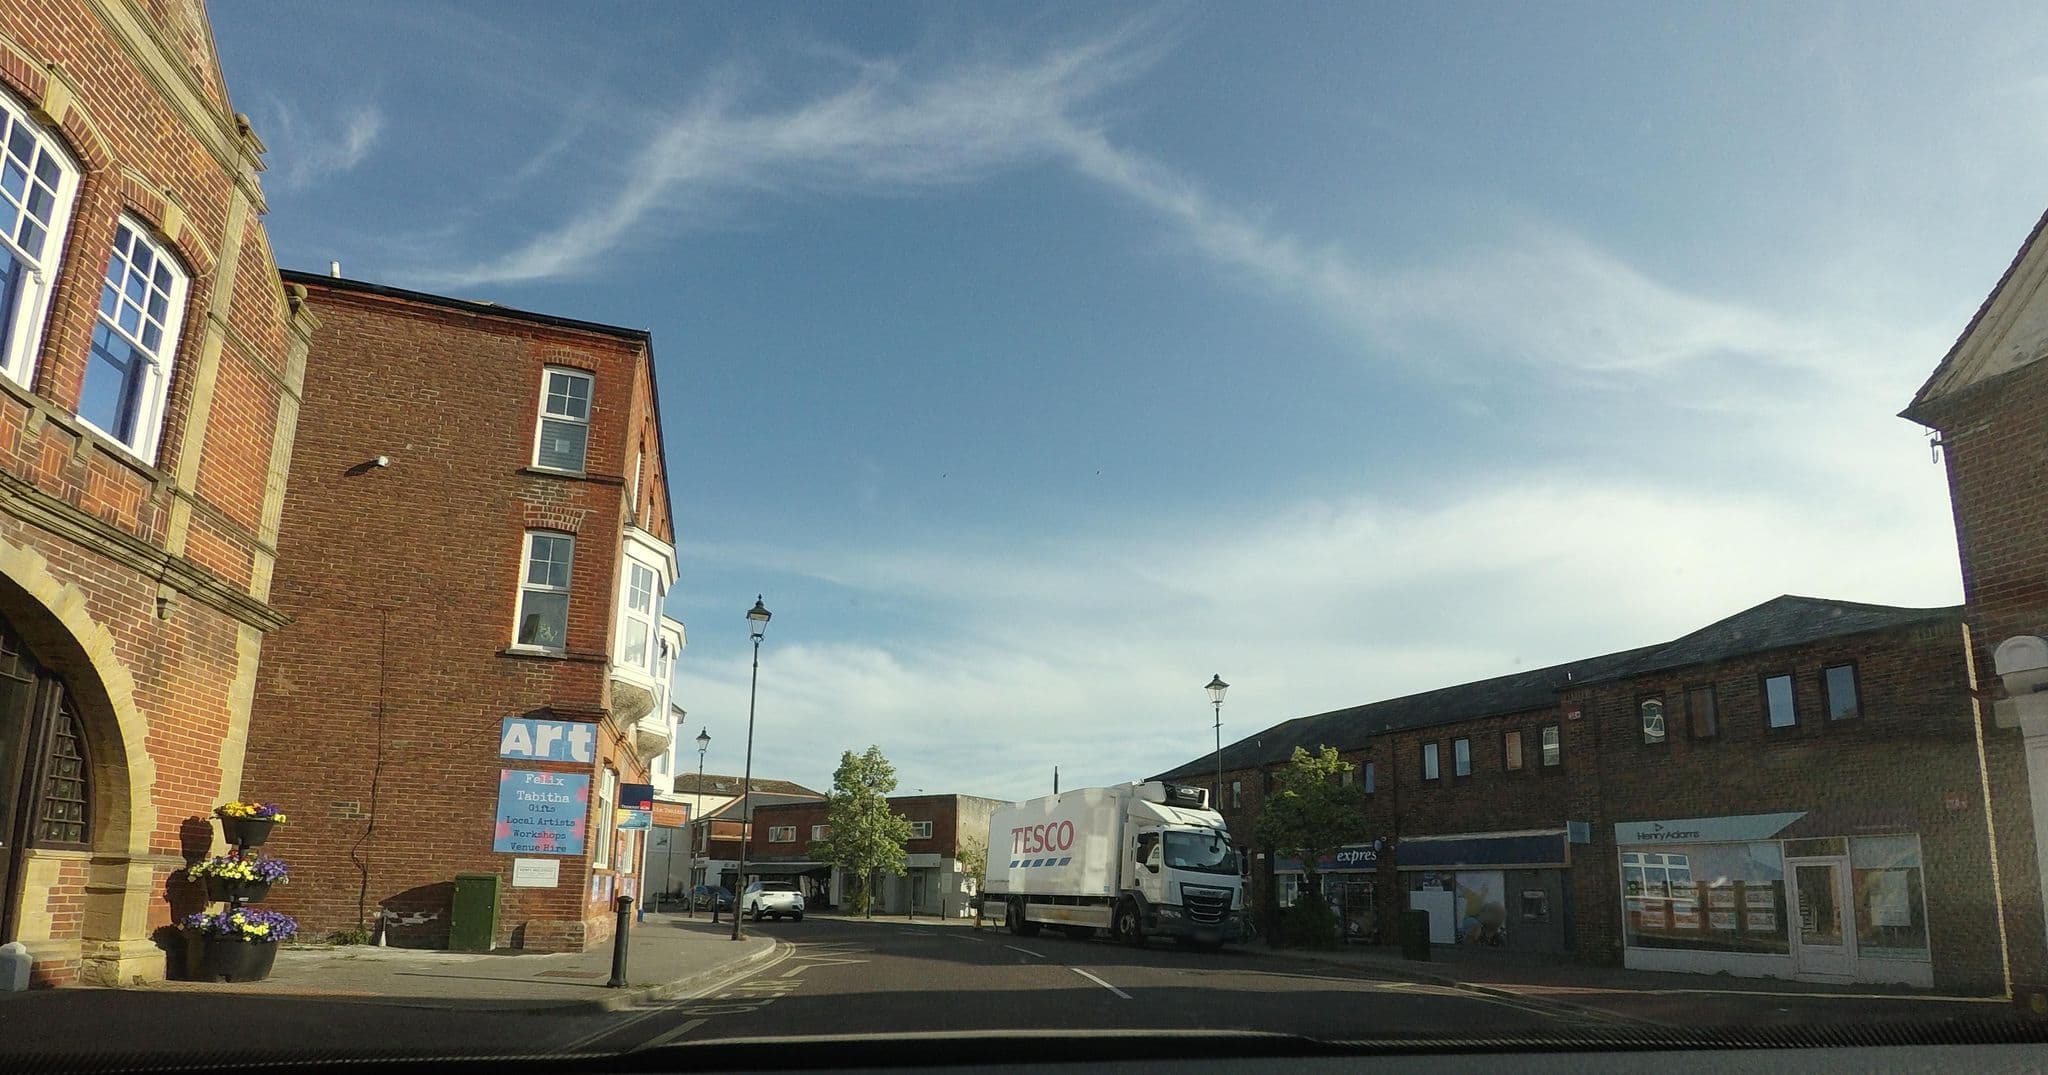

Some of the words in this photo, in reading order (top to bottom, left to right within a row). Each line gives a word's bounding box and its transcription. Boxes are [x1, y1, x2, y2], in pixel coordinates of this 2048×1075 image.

[500, 722, 593, 763] Art
[525, 773, 565, 786] Felix
[516, 790, 570, 803] Tabitha
[528, 803, 556, 813] Gifts
[506, 815, 535, 825] Local
[537, 817, 576, 827] Artists
[513, 829, 567, 841] Workshops
[1011, 820, 1075, 855] TESCO
[1637, 831, 1665, 841] Henry
[1665, 830, 1700, 839] Adams
[510, 842, 541, 852] Venue
[543, 843, 567, 853] Hire
[1336, 849, 1378, 865] expres
